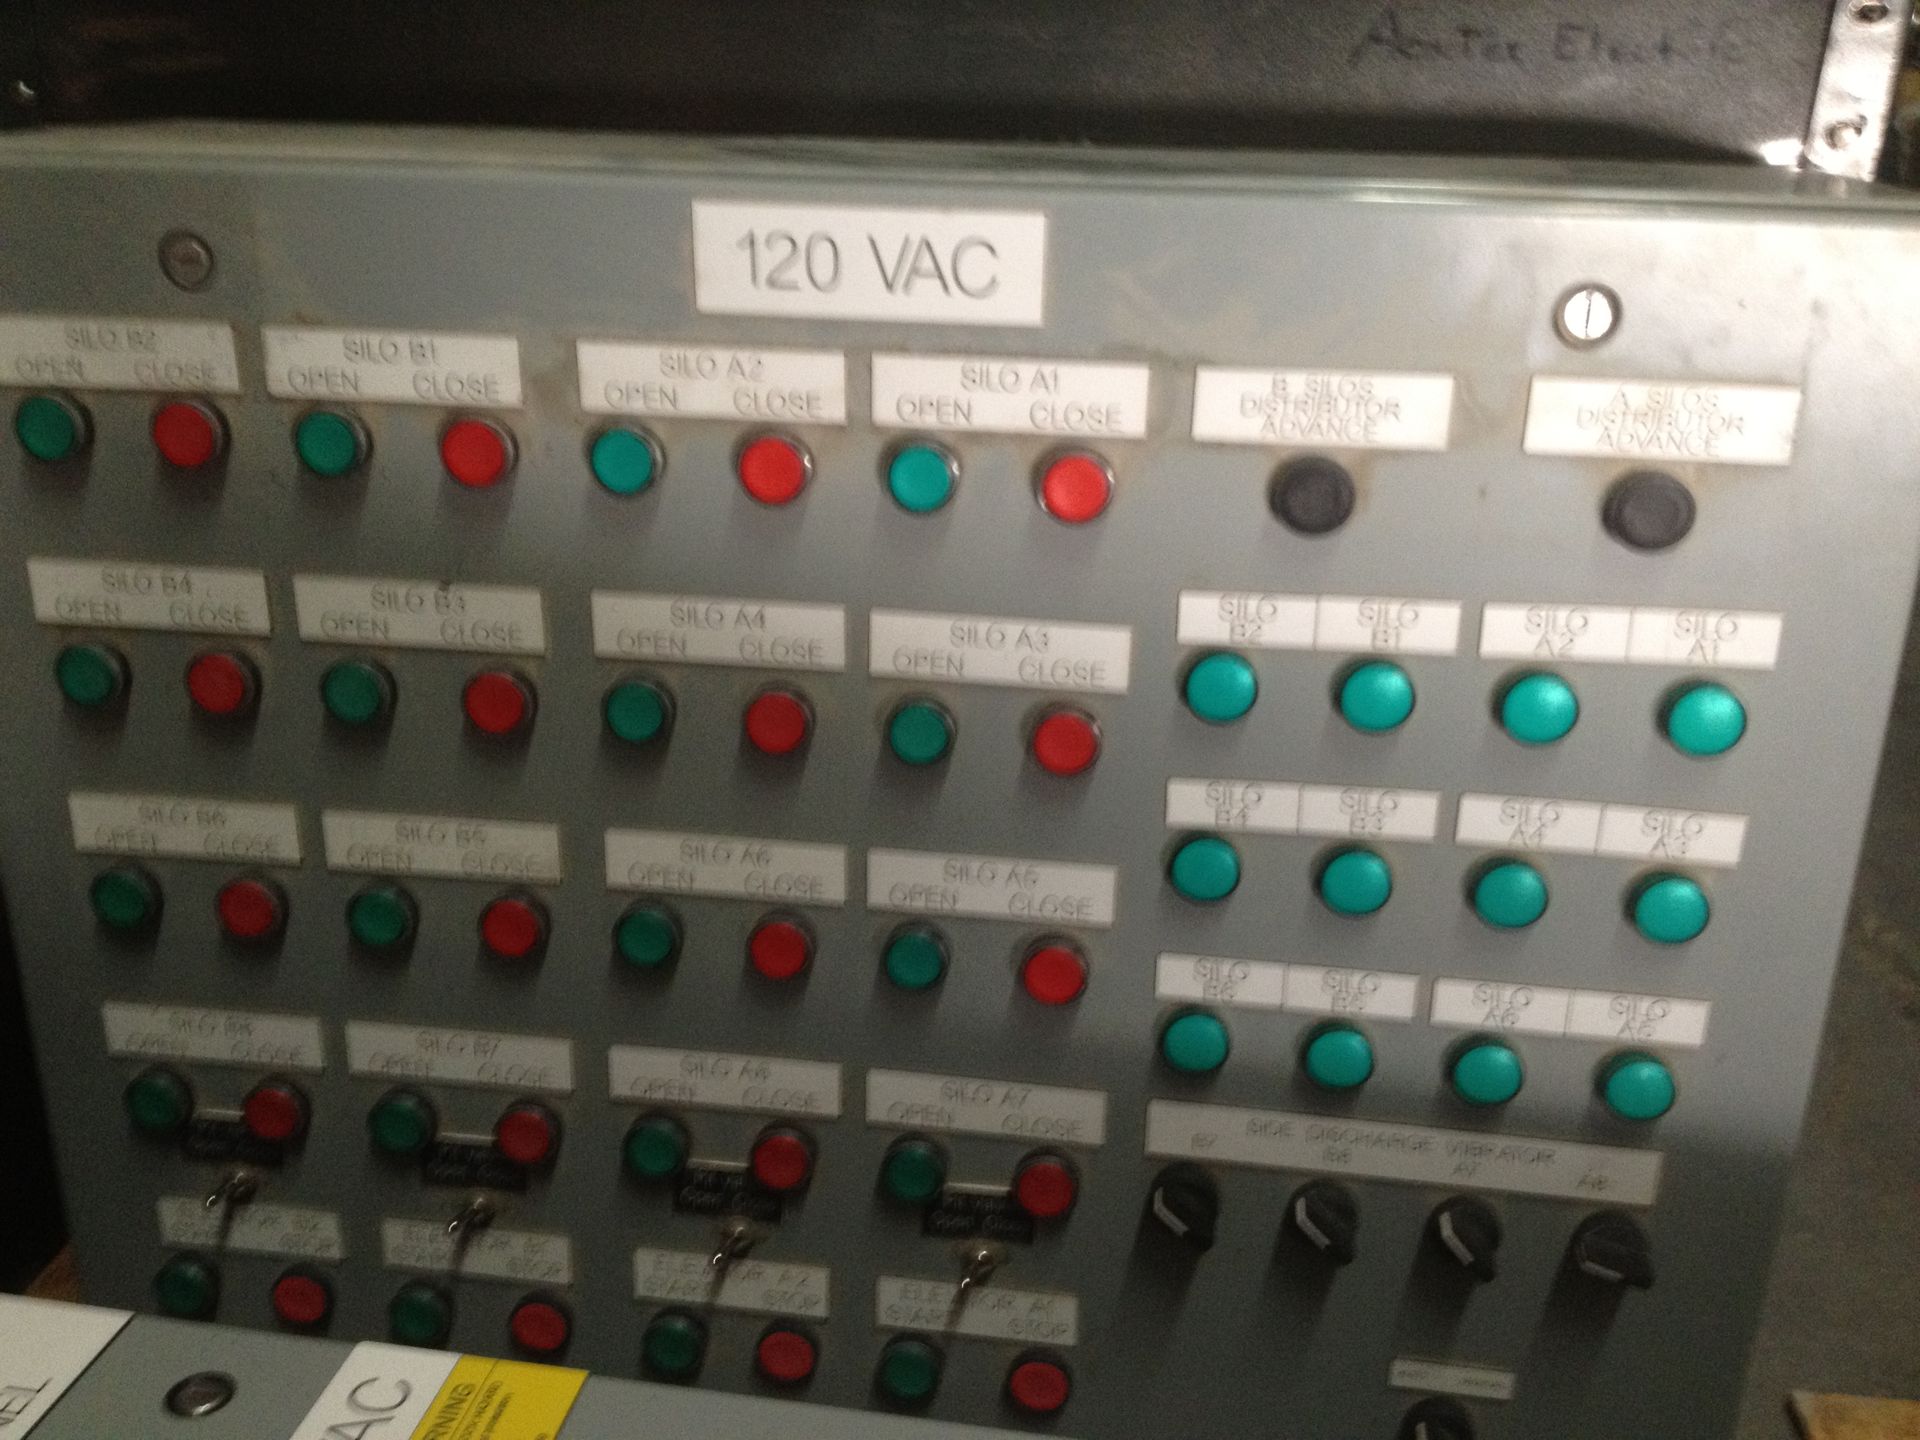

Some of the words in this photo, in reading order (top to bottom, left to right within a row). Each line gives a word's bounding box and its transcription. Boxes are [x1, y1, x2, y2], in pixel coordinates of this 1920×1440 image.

[736, 228, 842, 293] 120
[869, 234, 1000, 299] VAC
[64, 322, 118, 350] SILO
[342, 334, 400, 364] SILO
[408, 336, 439, 366] B1
[16, 353, 85, 381] OPEN
[134, 358, 217, 386] CLOSE
[659, 350, 720, 381] SILO
[726, 353, 765, 382] A2
[960, 362, 1022, 393] SILO
[1029, 366, 1060, 395] A1
[287, 365, 359, 394] OPEN
[412, 369, 501, 400] CLOSE
[1304, 375, 1375, 399] SILOS
[604, 379, 679, 410] OPEN
[733, 387, 822, 418] CLOSE
[895, 392, 972, 424] OPEN
[1029, 400, 1123, 432] CLOSE
[1239, 394, 1402, 422] DISTRIBUTOR
[1609, 385, 1630, 410] A
[1647, 386, 1720, 412] SILOS
[1261, 415, 1378, 442] ADVANCE
[1576, 404, 1745, 436] DISTRIBUTOR
[1596, 428, 1720, 457] ADVANCE
[101, 567, 153, 594] SILO
[55, 594, 122, 621] OPEN
[170, 600, 252, 628] CLOSE
[371, 583, 426, 614] SILO
[1218, 593, 1279, 624] SILO
[320, 610, 391, 640] OPEN
[440, 618, 523, 647] CLOSE
[670, 600, 725, 630] SILO
[734, 603, 768, 632] A4
[1356, 599, 1420, 630] SILO
[1524, 606, 1590, 637] SILO
[1673, 611, 1740, 643] SILO
[616, 627, 688, 656] OPEN
[739, 635, 825, 663] CLOSE
[950, 620, 1007, 651] SILO
[1015, 624, 1050, 653] A3
[1534, 632, 1575, 657] A2
[1686, 637, 1720, 664] A1
[892, 645, 966, 677] OPEN
[1018, 655, 1109, 687] CLOSE
[1205, 781, 1266, 810] SILO
[1339, 787, 1399, 816] SILO
[1499, 799, 1562, 829] SILO
[1640, 807, 1704, 839] SILO
[347, 842, 414, 869] OPEN
[461, 850, 543, 877] CLOSE
[680, 838, 731, 866] SILO
[628, 861, 698, 889] OPEN
[744, 870, 825, 898] CLOSE
[943, 858, 998, 887] SILO
[889, 882, 960, 910] OPEN
[1008, 891, 1095, 919] CLOSE
[1472, 981, 1536, 1009] SILO
[1607, 994, 1671, 1022] SILO
[1001, 1113, 1086, 1138] CLOSE
